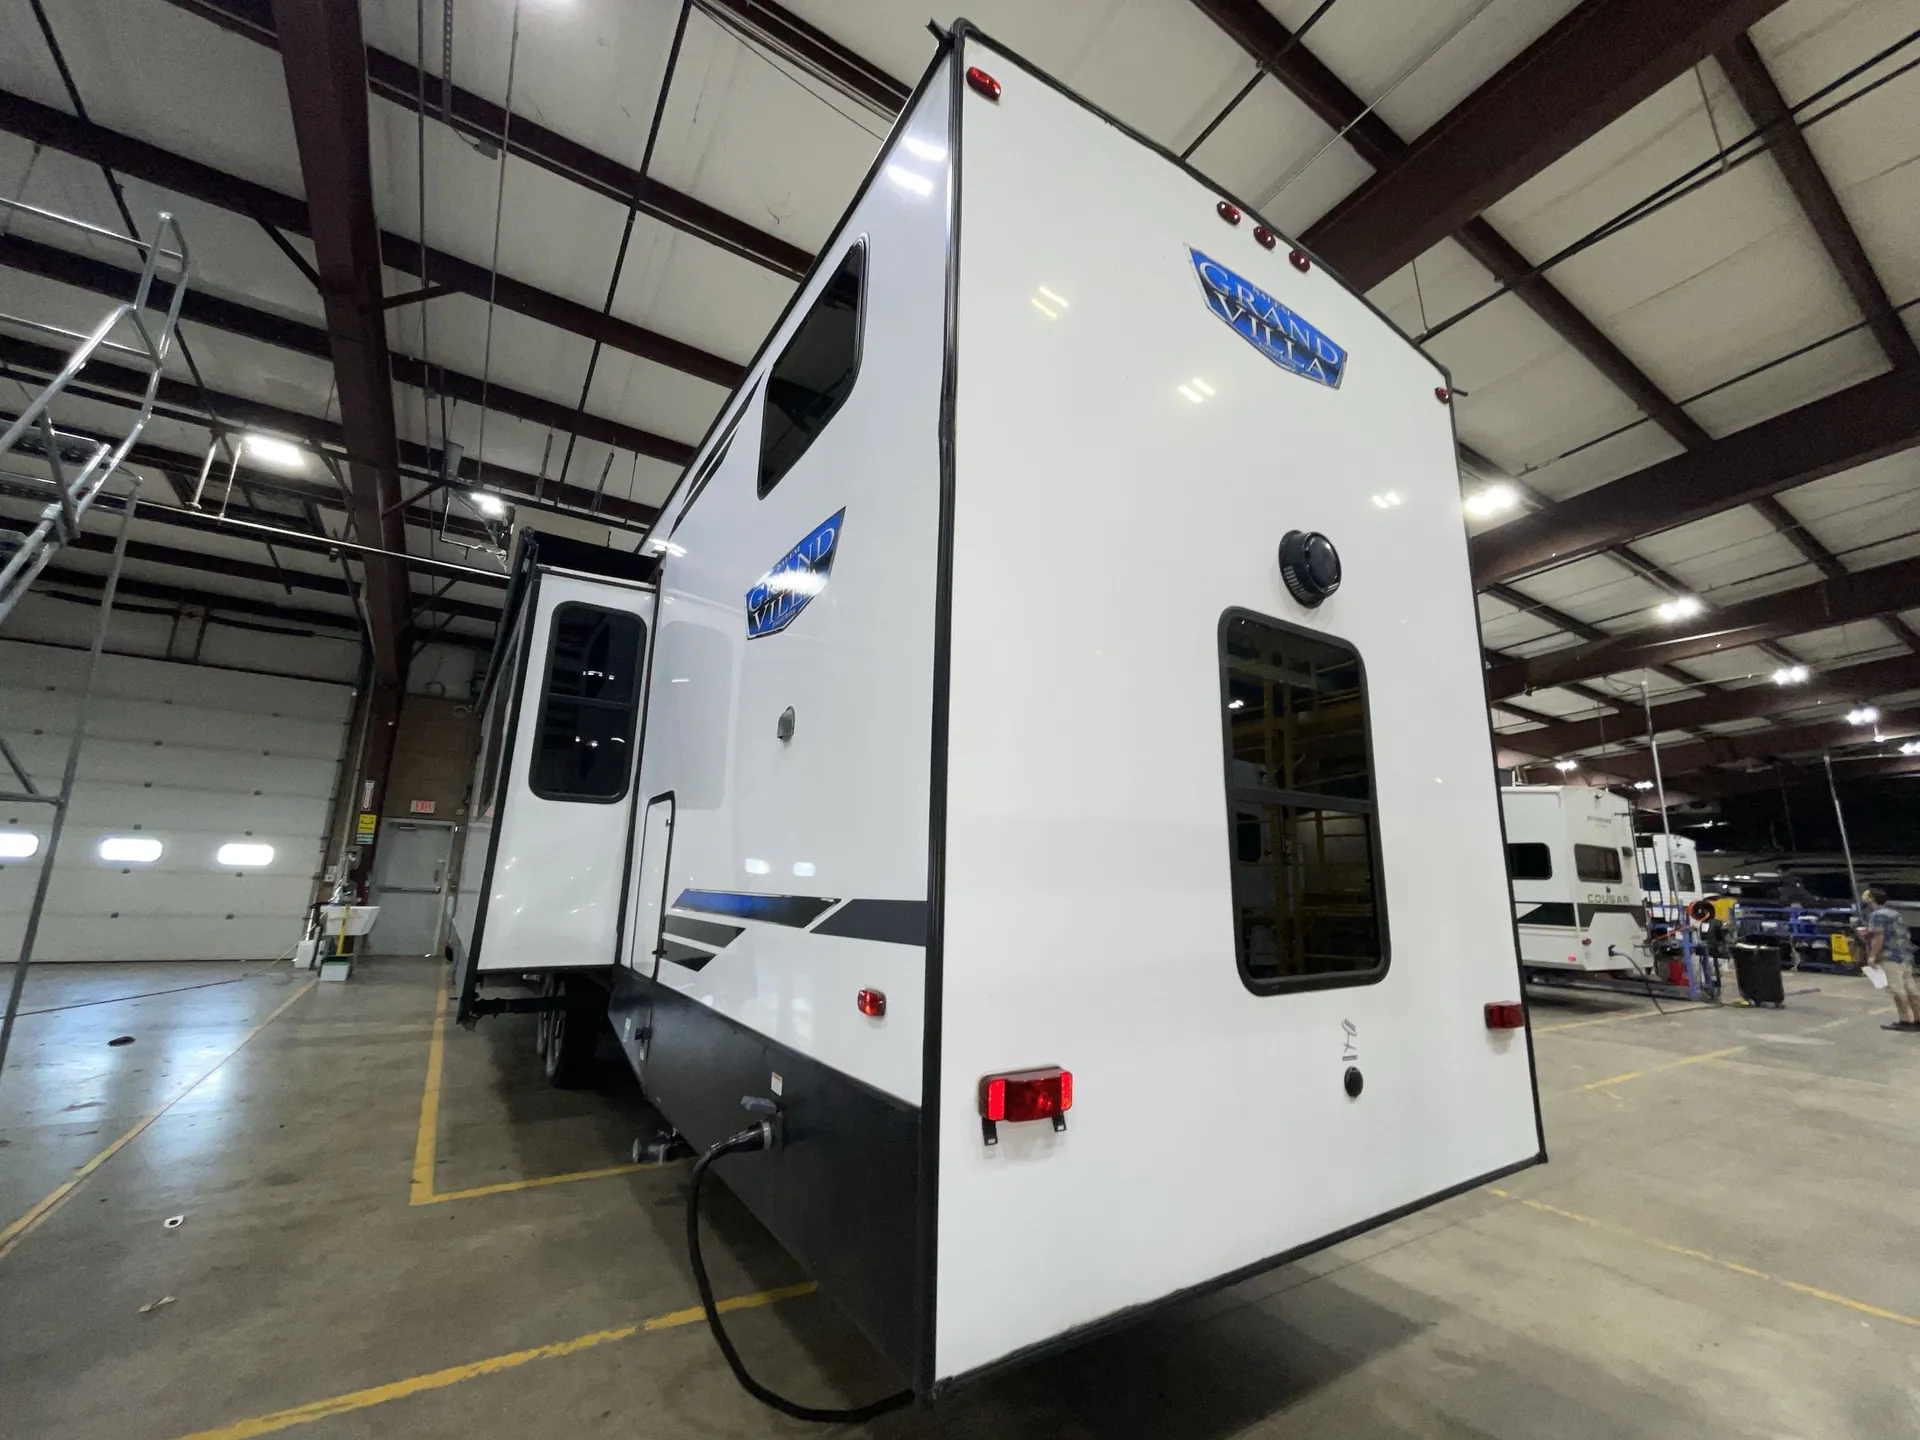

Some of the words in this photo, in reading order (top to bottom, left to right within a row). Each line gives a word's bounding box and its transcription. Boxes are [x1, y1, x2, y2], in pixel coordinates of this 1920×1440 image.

[1200, 262, 1339, 365] GRAND
[1214, 290, 1328, 383] VILLA
[753, 575, 815, 631] VILL
[1587, 894, 1629, 904] COUGAR
